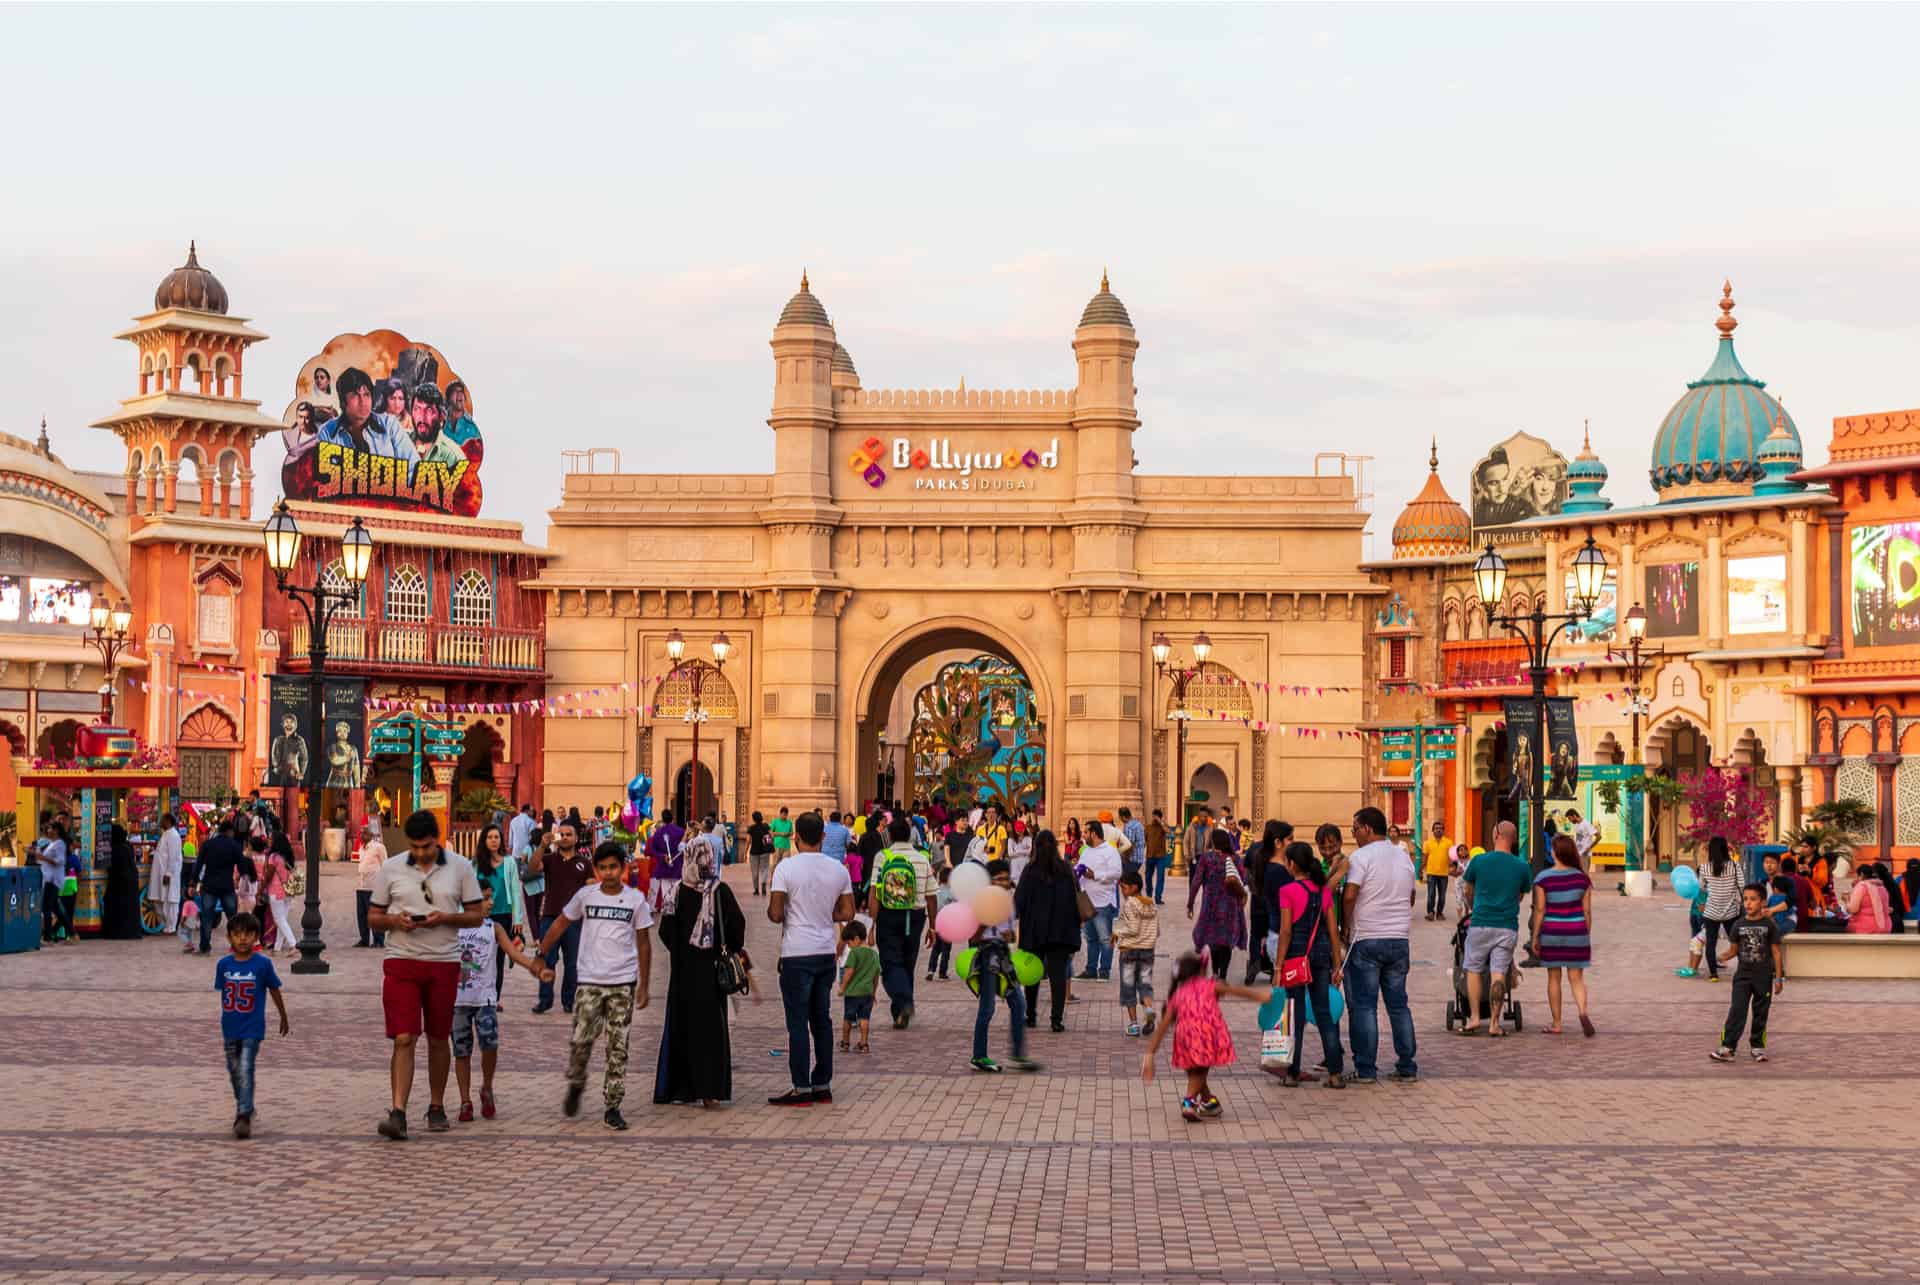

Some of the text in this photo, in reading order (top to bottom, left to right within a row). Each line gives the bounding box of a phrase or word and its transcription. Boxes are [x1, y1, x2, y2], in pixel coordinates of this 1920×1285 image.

[892, 437, 1060, 476] Bollywood
[317, 440, 471, 513] SHOLAY
[915, 479, 1036, 489] PARKS DUBAI
[223, 980, 257, 1013] 35
